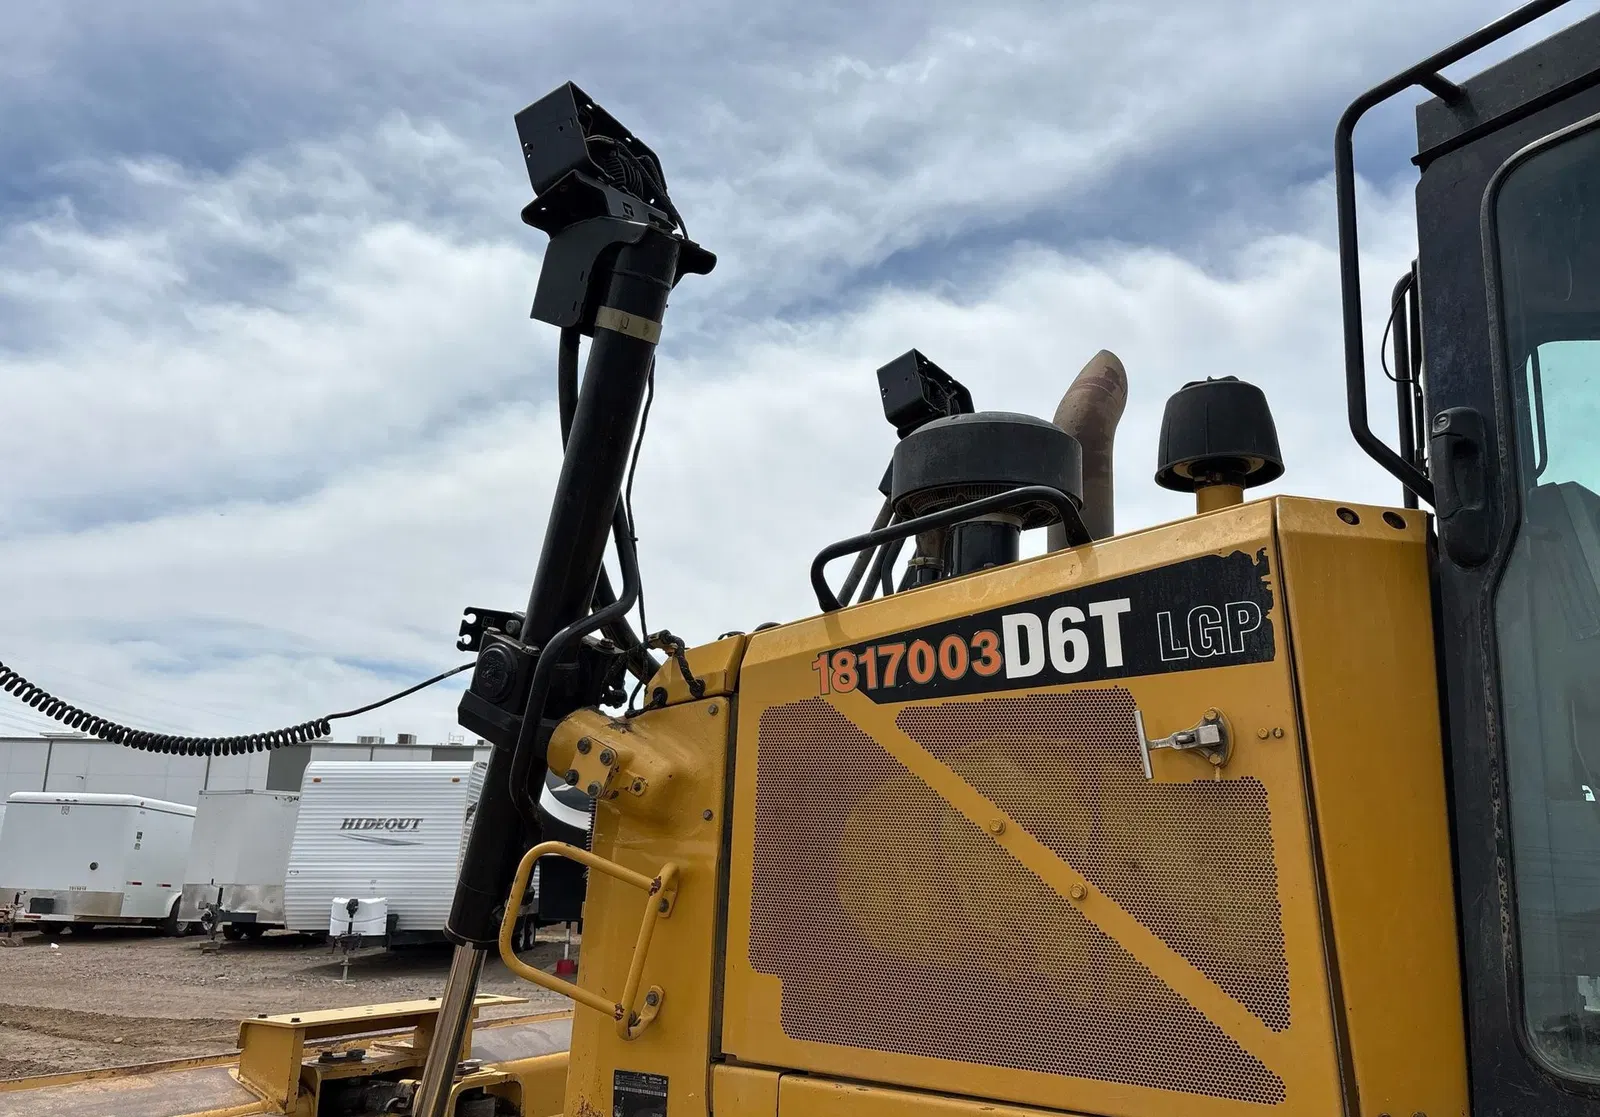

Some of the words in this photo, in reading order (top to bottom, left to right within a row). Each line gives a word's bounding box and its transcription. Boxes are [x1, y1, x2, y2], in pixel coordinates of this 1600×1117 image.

[811, 628, 1004, 696] 1817003
[1001, 597, 1131, 679] D6T
[1156, 600, 1262, 662] LGP
[340, 817, 424, 831] HIDEOUT
